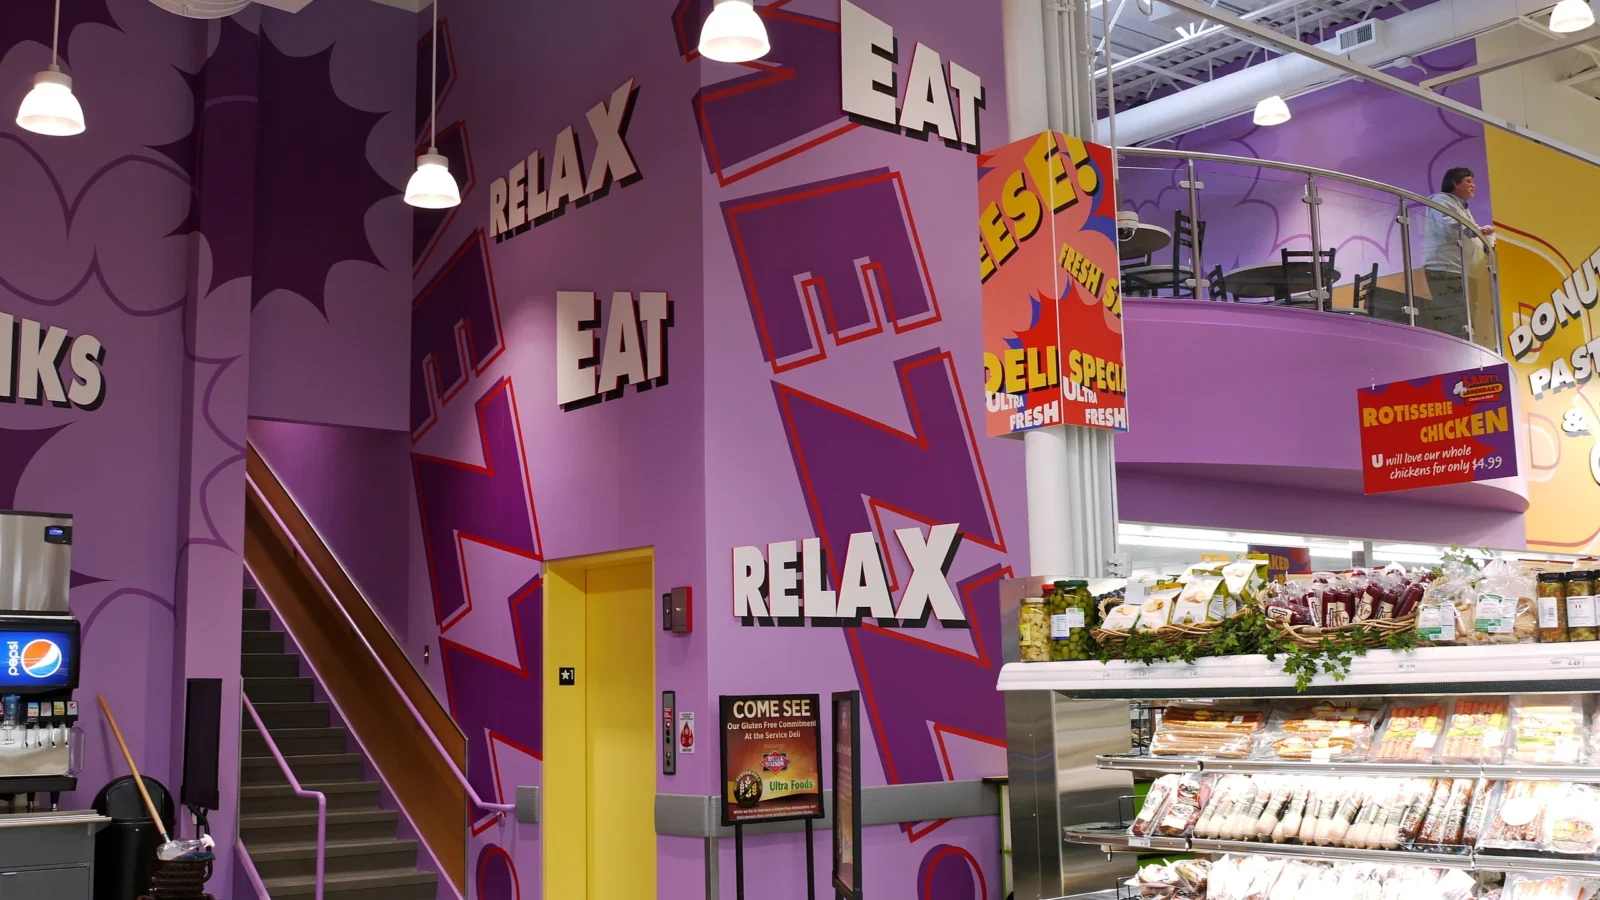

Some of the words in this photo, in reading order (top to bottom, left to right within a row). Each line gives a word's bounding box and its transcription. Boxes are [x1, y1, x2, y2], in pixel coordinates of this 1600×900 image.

[840, 0, 984, 151] EAT
[490, 76, 641, 241] RELAX
[1058, 242, 1104, 298] FRESH
[557, 291, 672, 407] EAT
[984, 346, 1059, 395] DELI
[985, 391, 1024, 413] ULTRA
[1063, 376, 1098, 404] ULTRA
[1010, 400, 1059, 430] FRESH
[1085, 408, 1127, 429] FRESH
[1363, 401, 1453, 428] ROTISSERIE
[1420, 406, 1509, 443] CHICKEN
[1372, 454, 1384, 468] U
[1386, 453, 1403, 466] will
[1404, 451, 1422, 463] love
[1424, 451, 1441, 460] our
[1442, 444, 1472, 458] whole
[1389, 464, 1431, 480] chickens
[1432, 462, 1445, 476] for
[1447, 459, 1470, 474] only
[1472, 456, 1503, 471] $4.99
[733, 523, 968, 626] RELAX
[6, 641, 20, 676] pepsi
[733, 700, 780, 719] COME
[783, 700, 811, 717] SEE
[727, 722, 740, 730] Our
[741, 721, 763, 729] Gluten
[744, 732, 752, 740] At
[765, 731, 788, 739] Service
[769, 781, 789, 791] Ultra
[791, 779, 814, 790] Foods
